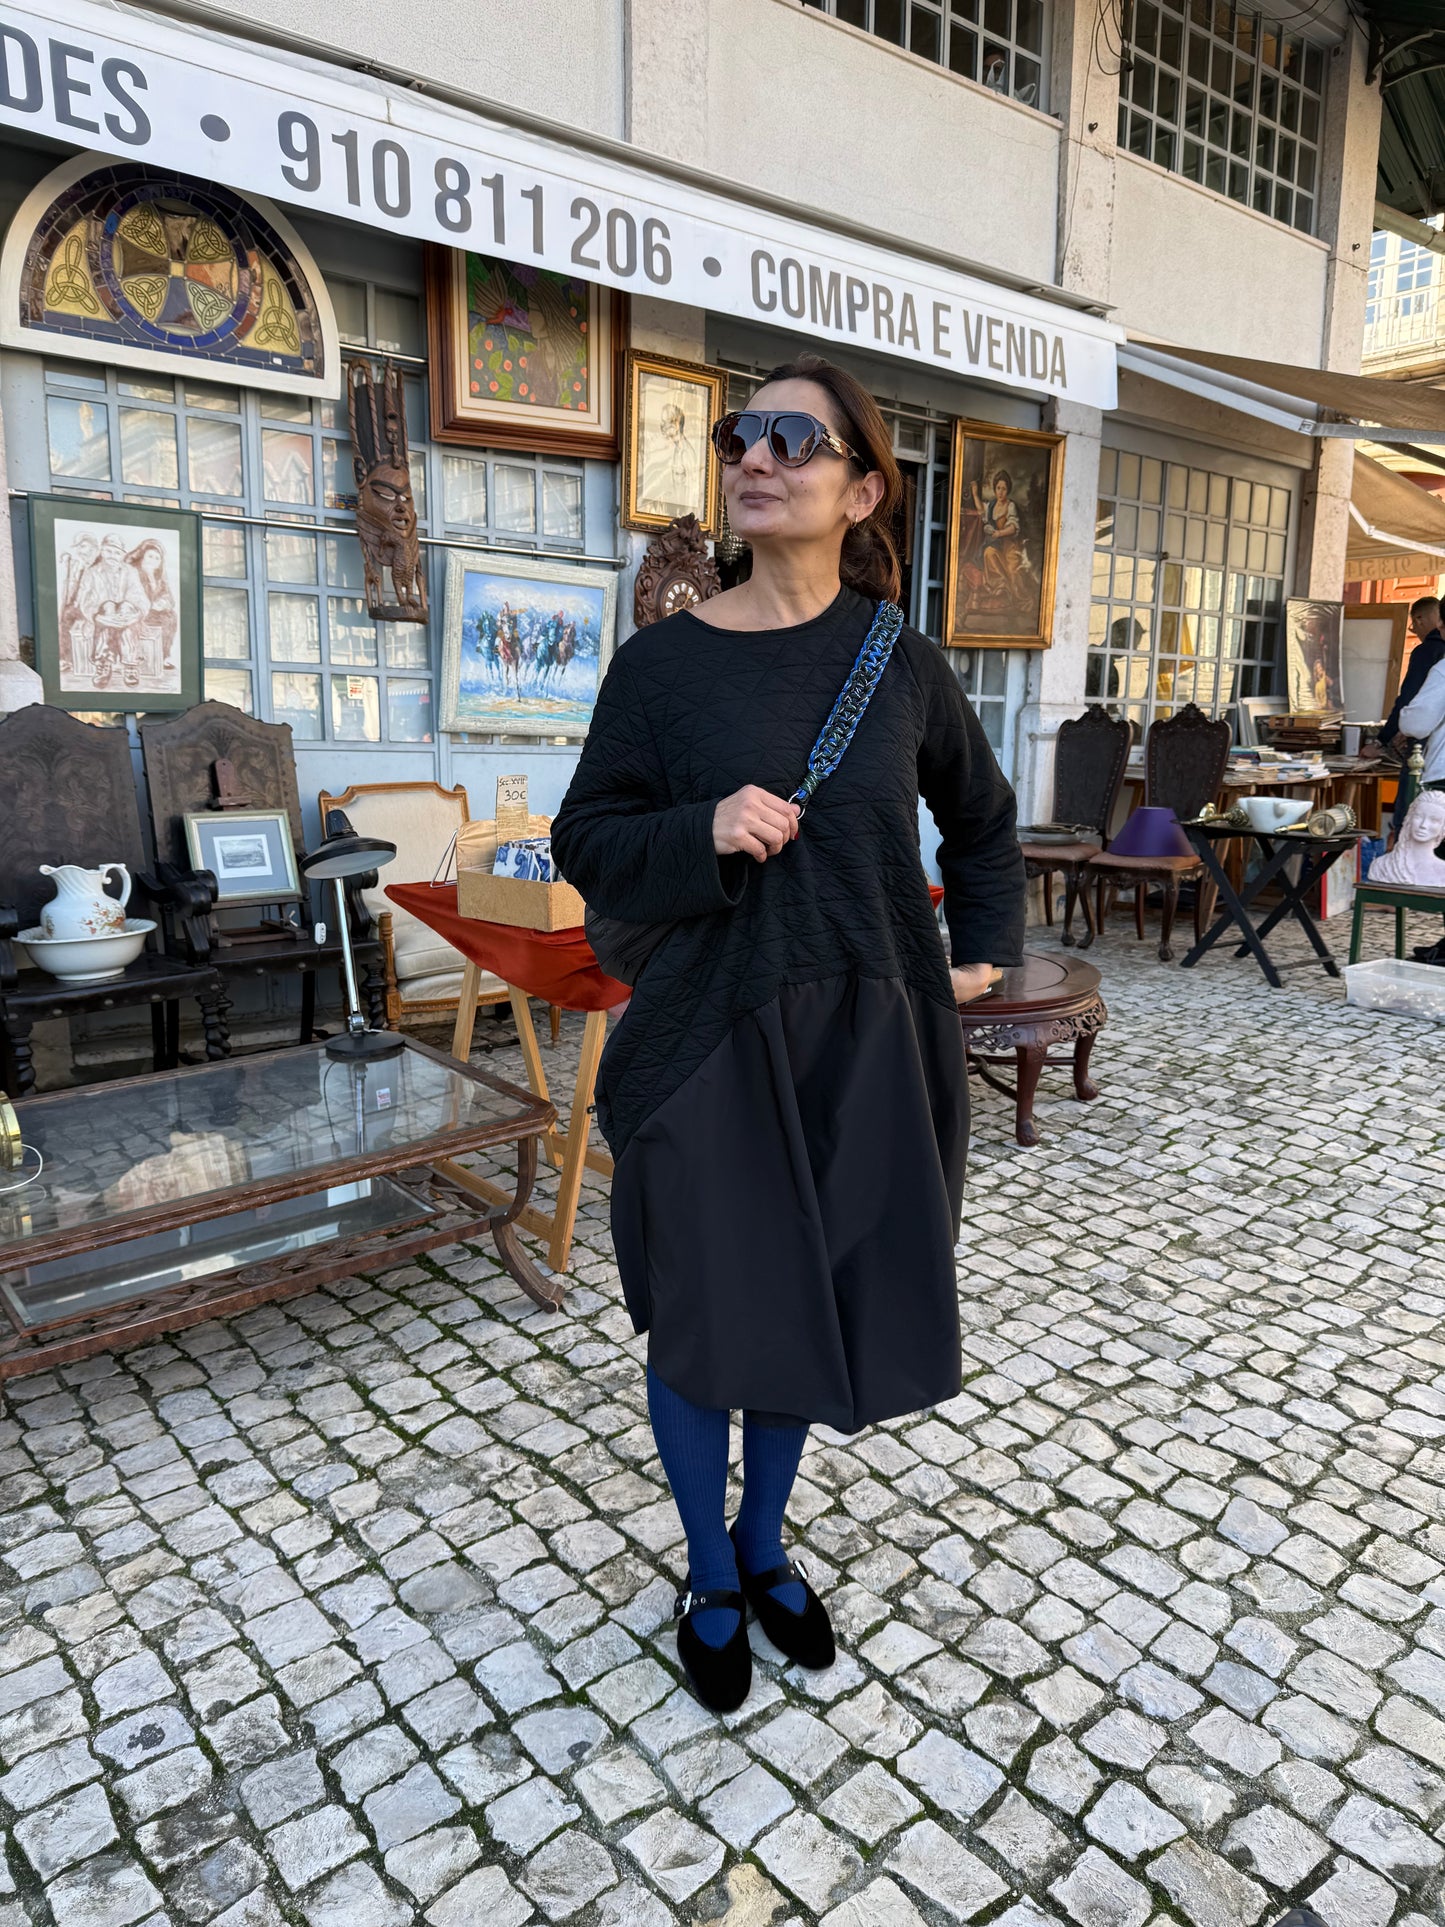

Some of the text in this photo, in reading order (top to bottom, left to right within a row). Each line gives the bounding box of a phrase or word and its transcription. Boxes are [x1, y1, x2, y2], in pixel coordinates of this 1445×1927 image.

[0, 21, 1068, 389] DES 910 811 206 COMPRA E VENDA
[504, 789, 526, 802] 30€
